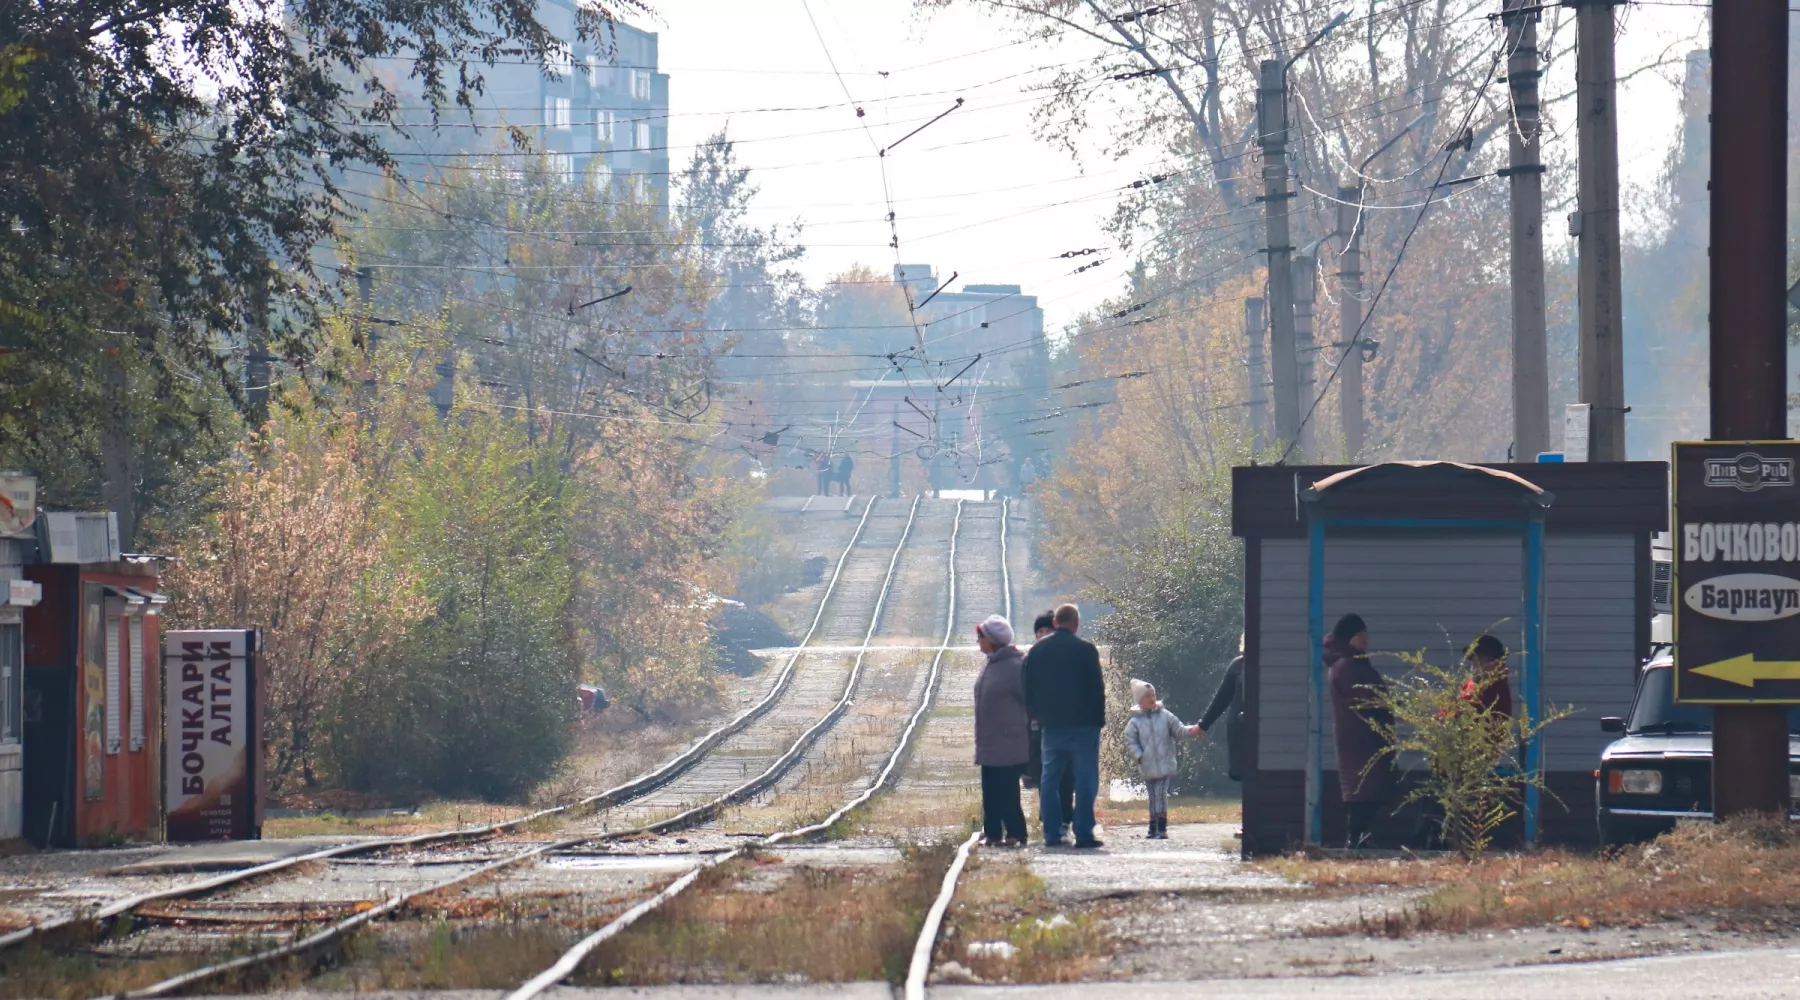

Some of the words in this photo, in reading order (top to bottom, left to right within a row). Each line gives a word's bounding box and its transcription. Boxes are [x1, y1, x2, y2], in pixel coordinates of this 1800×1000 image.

[1762, 462, 1788, 477] Pub
[1684, 522, 1800, 562] БОЧКОВО
[1701, 585, 1800, 615] Барнаул
[207, 641, 231, 746] АЛТАЙ
[182, 641, 204, 795] БОЧКАРИ
